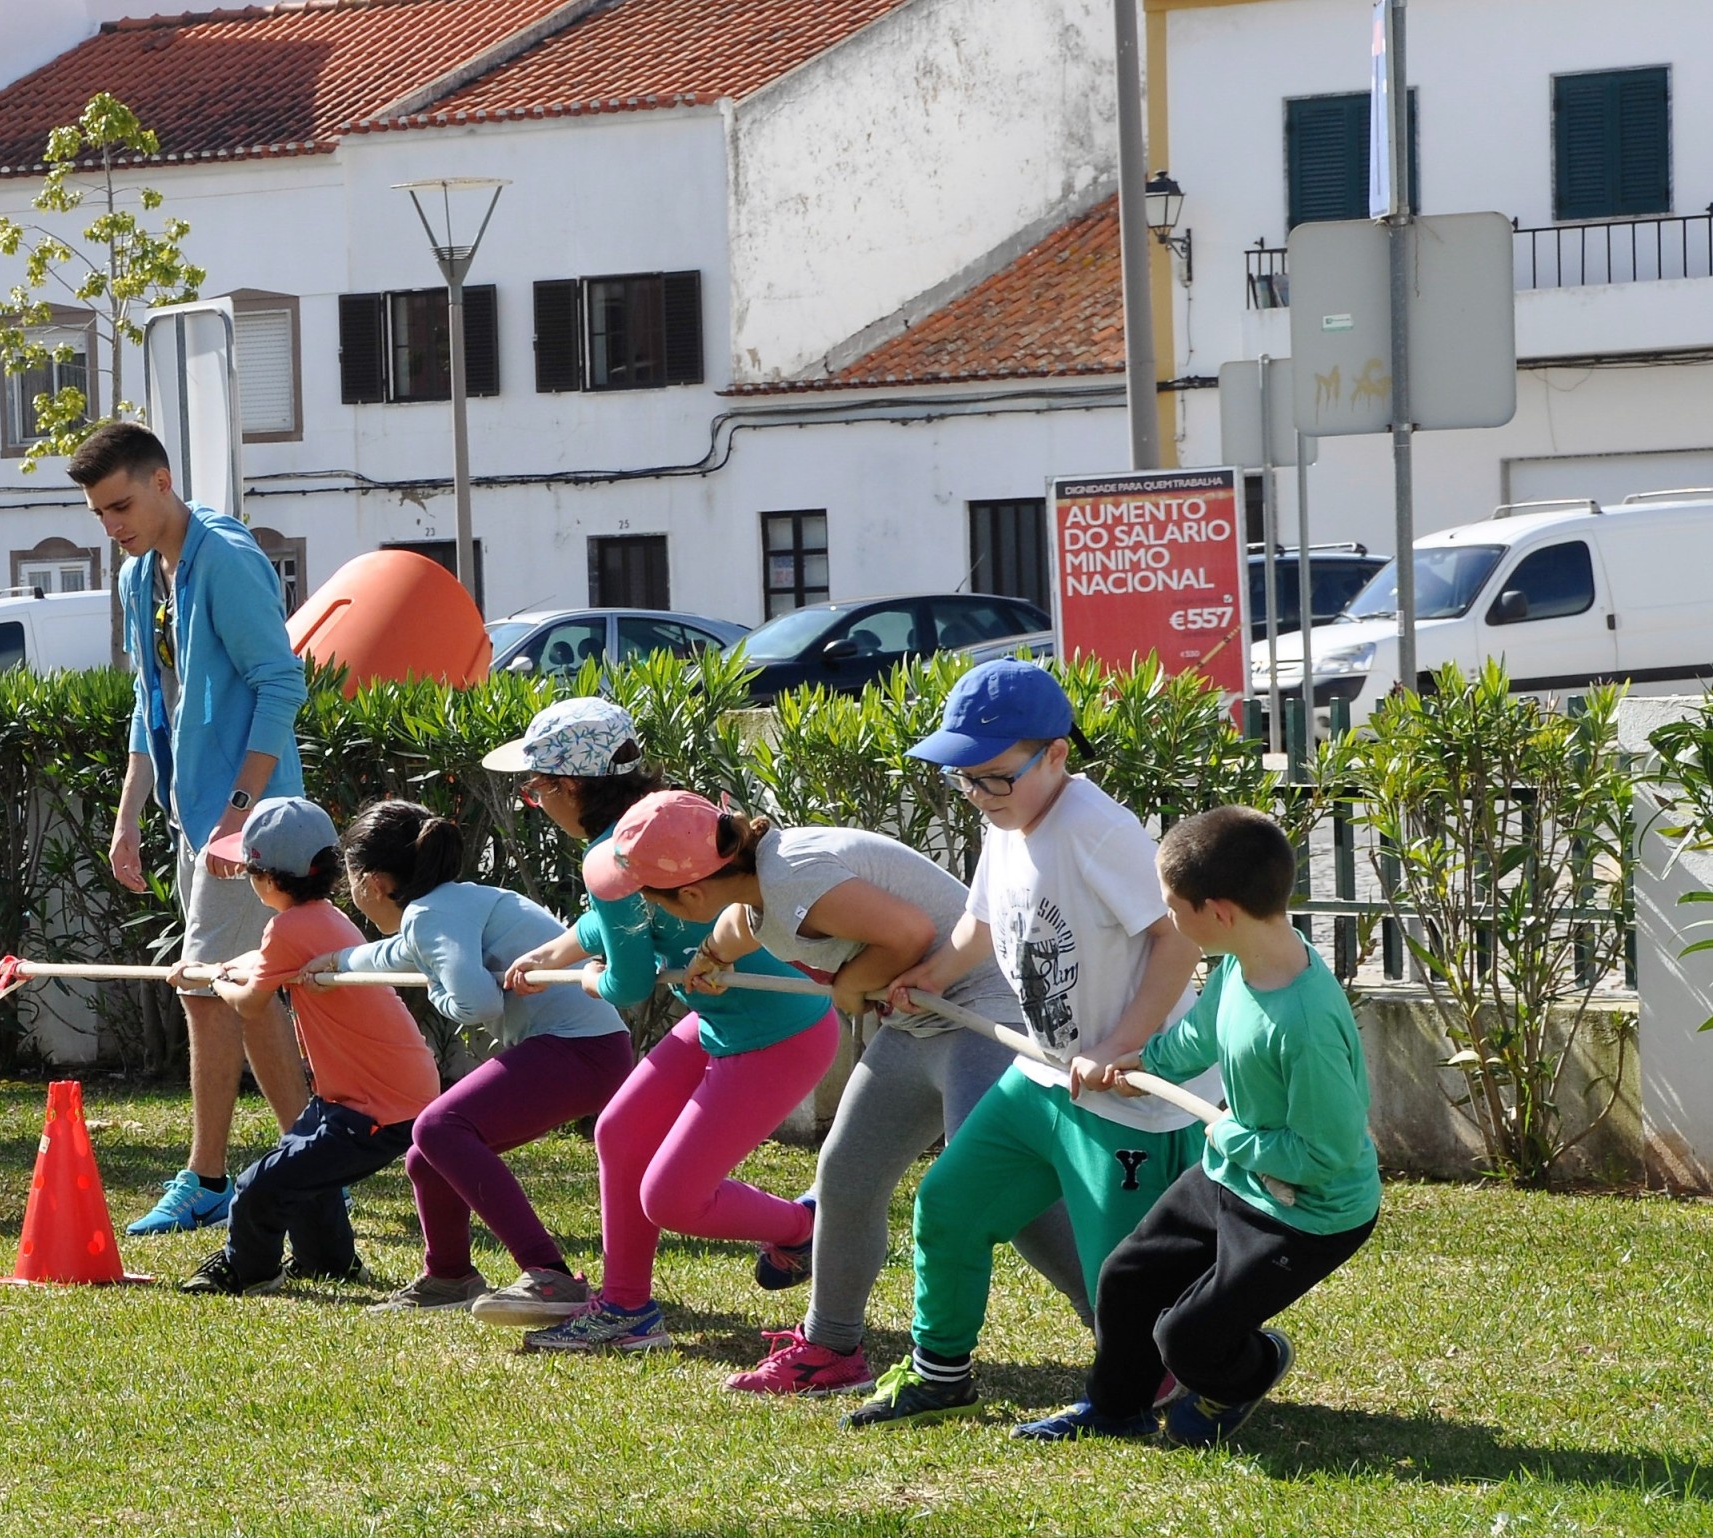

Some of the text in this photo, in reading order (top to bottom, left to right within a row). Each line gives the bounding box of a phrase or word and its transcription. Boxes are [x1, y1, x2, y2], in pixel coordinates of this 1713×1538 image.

[1064, 476, 1224, 496] DIGNIDADE PARA QUEM TRABALHA
[618, 519, 630, 530] 25
[1064, 498, 1207, 528] AUMENTO
[424, 527, 436, 538] 23
[1064, 526, 1110, 551] DO
[1066, 567, 1216, 597] NACIONAL
[1168, 606, 1234, 631] €557
[1115, 1149, 1148, 1191] Y
